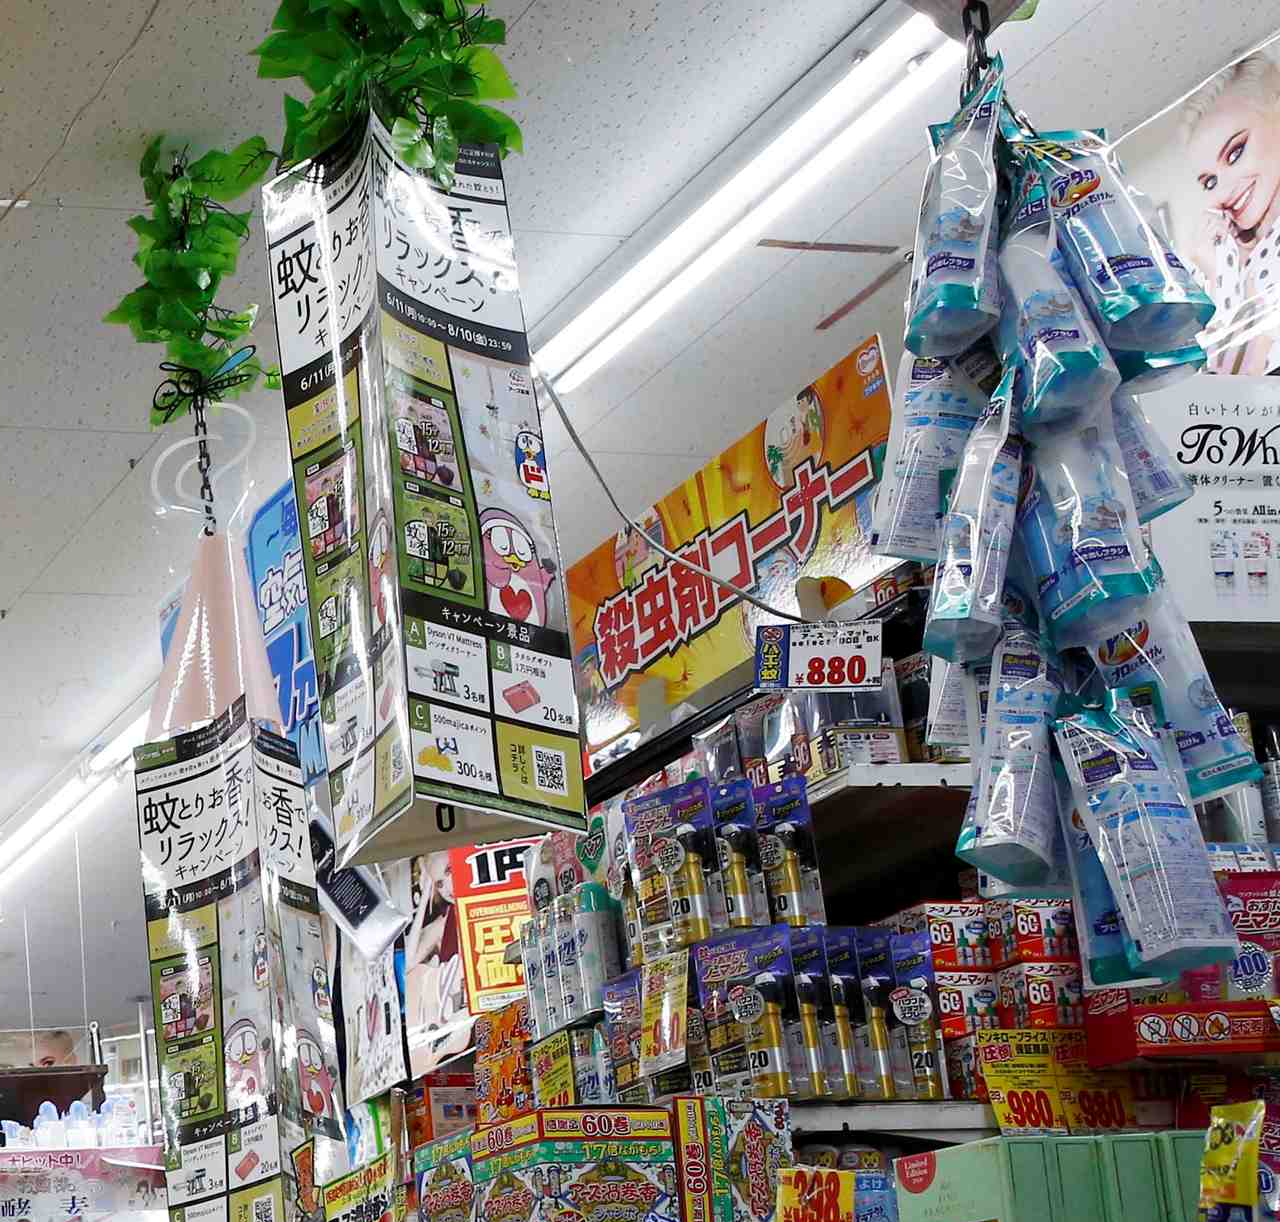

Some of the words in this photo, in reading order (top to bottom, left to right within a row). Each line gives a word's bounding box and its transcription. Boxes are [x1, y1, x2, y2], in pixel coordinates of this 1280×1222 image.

[596, 454, 877, 690] 殺虫剤コーナー
[409, 622, 419, 637] A
[495, 643, 506, 661] B
[794, 673, 804, 685] ¥
[807, 655, 866, 685] 880
[463, 684, 485, 704] 3名様
[414, 704, 424, 721] C
[543, 705, 573, 726] 20名様
[456, 761, 493, 782] 300名様
[748, 1050, 769, 1070] 20
[912, 1051, 934, 1070] 20
[1007, 1090, 1055, 1128] 980
[1077, 1090, 1127, 1128] 980
[579, 1113, 632, 1136] 60巻
[568, 1182, 659, 1202] アース渦巻香
